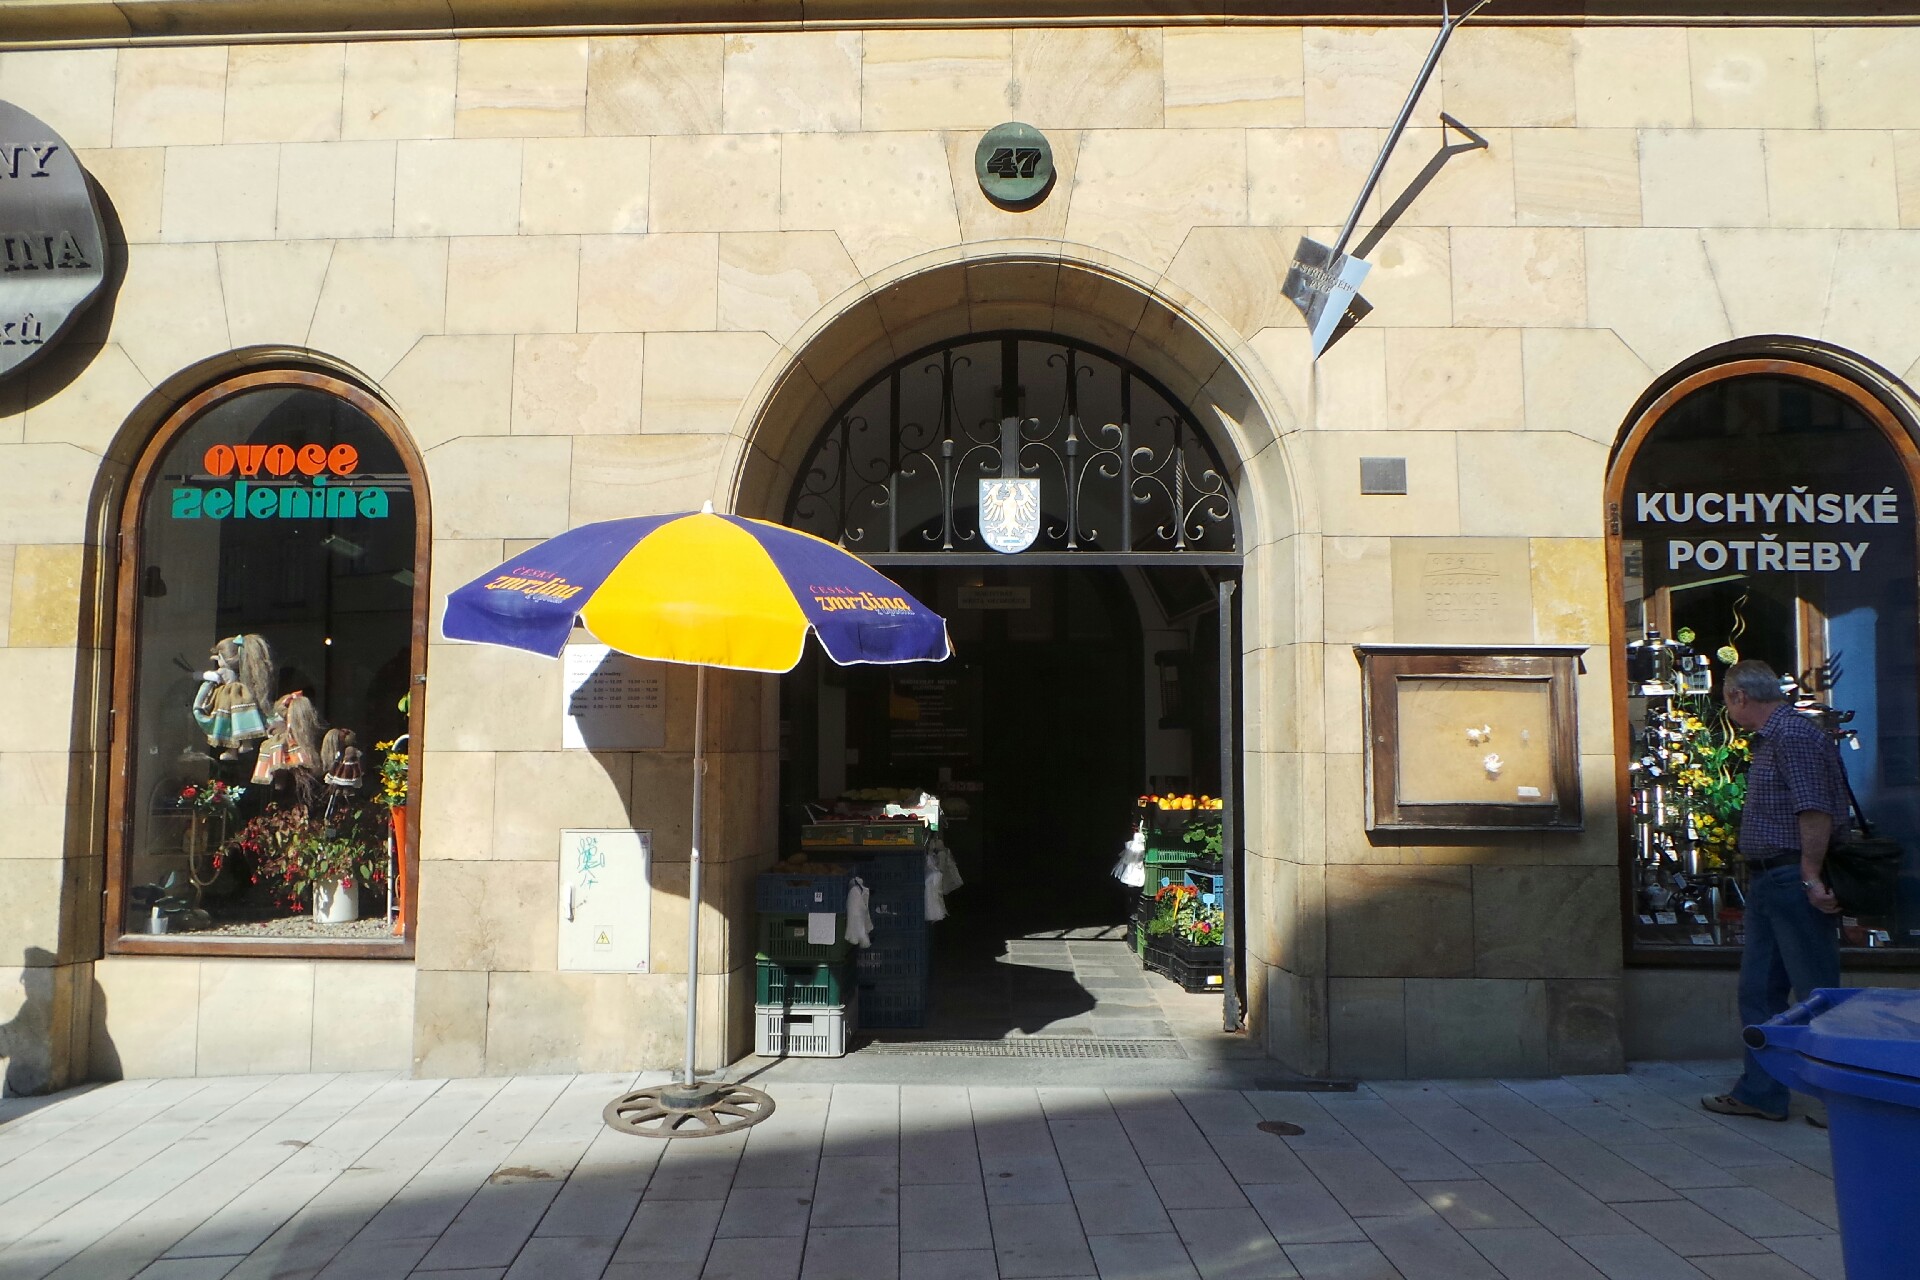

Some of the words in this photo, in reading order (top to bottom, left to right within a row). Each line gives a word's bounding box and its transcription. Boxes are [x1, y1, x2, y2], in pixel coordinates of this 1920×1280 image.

[986, 147, 1042, 179] 47
[202, 442, 359, 477] ovoce
[171, 475, 389, 519] zelenina
[1636, 485, 1899, 524] KUCHYŇSKÉ
[1668, 533, 1870, 572] POTŘEBY
[814, 591, 911, 612] zmrzlina
